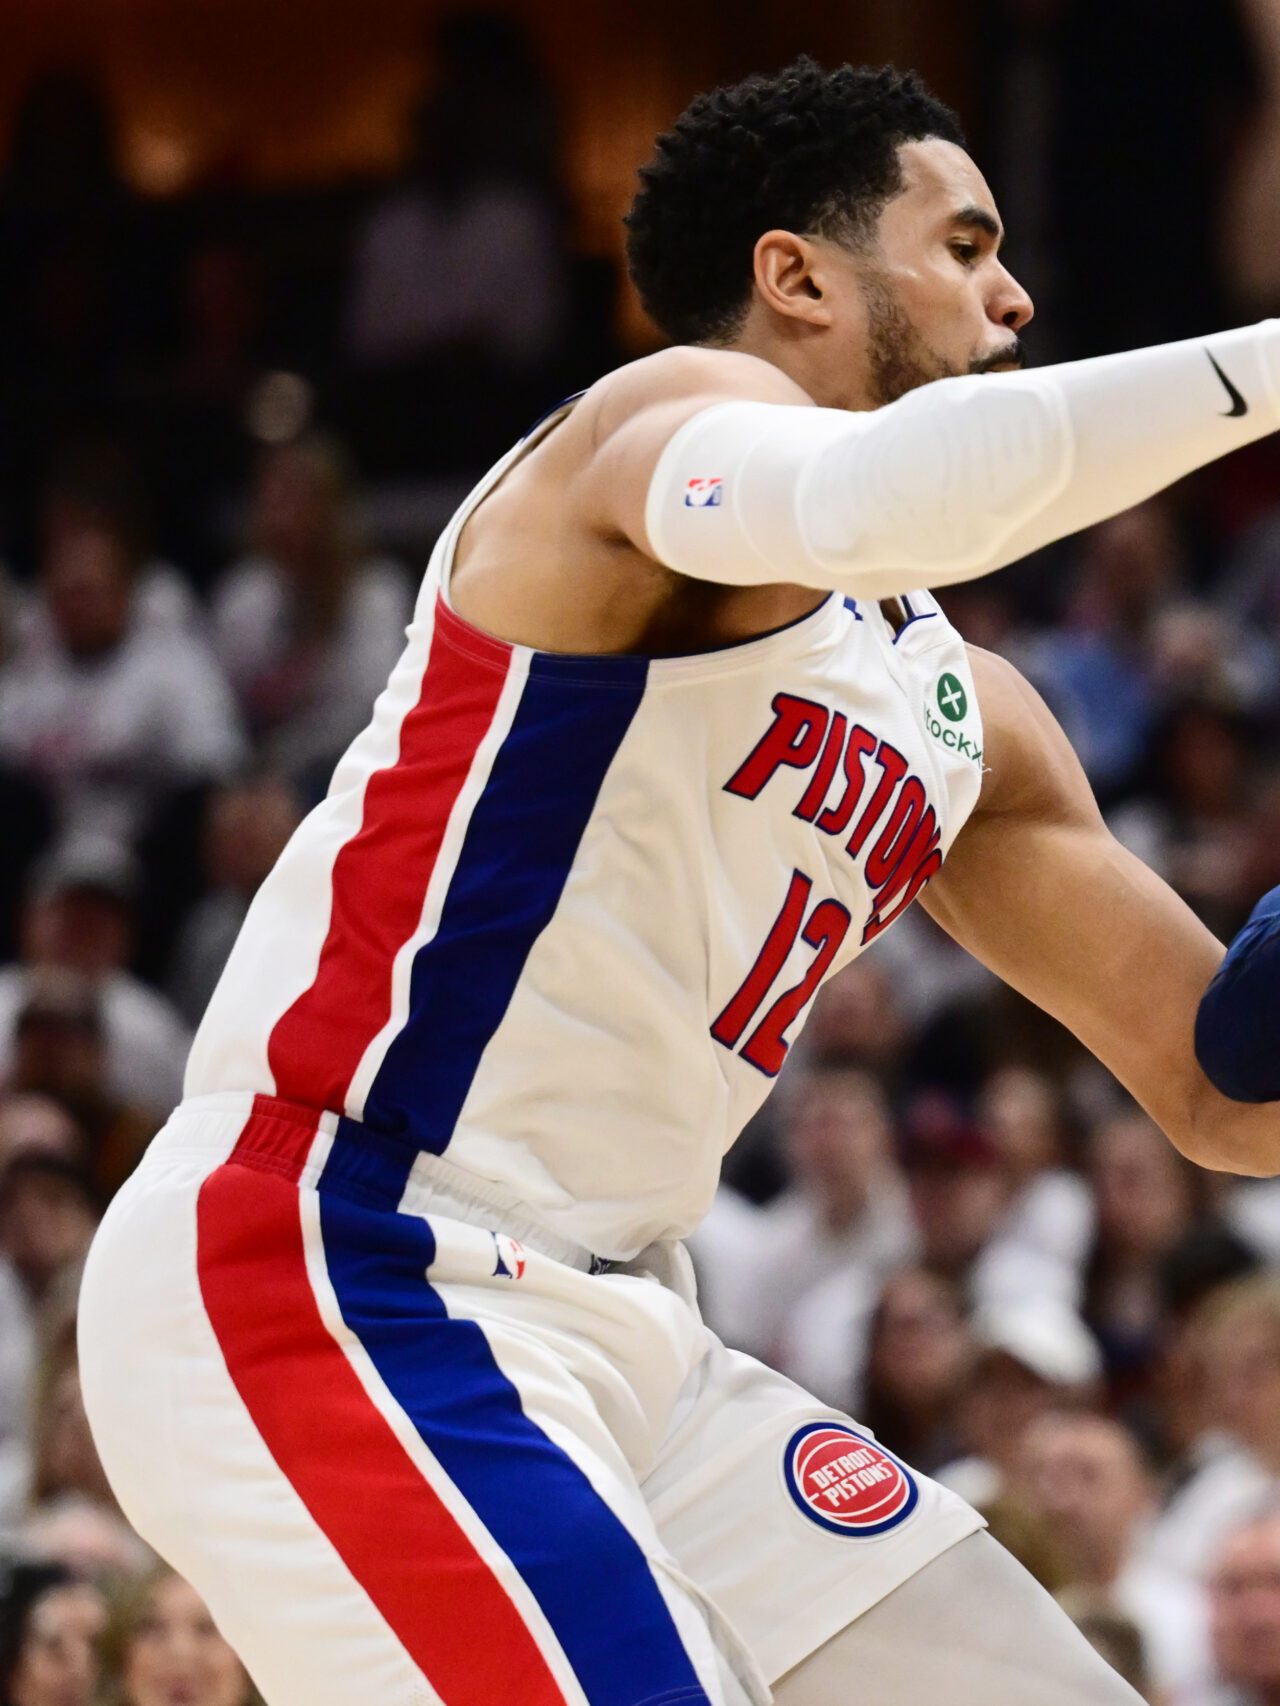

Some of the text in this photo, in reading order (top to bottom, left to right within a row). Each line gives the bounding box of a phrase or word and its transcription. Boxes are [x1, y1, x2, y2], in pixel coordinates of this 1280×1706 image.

[923, 701, 982, 769] tockX
[722, 691, 943, 947] PISTONS
[710, 867, 851, 1078] 12
[808, 1448, 877, 1490] DETROIT
[821, 1462, 893, 1508] PISTONS
